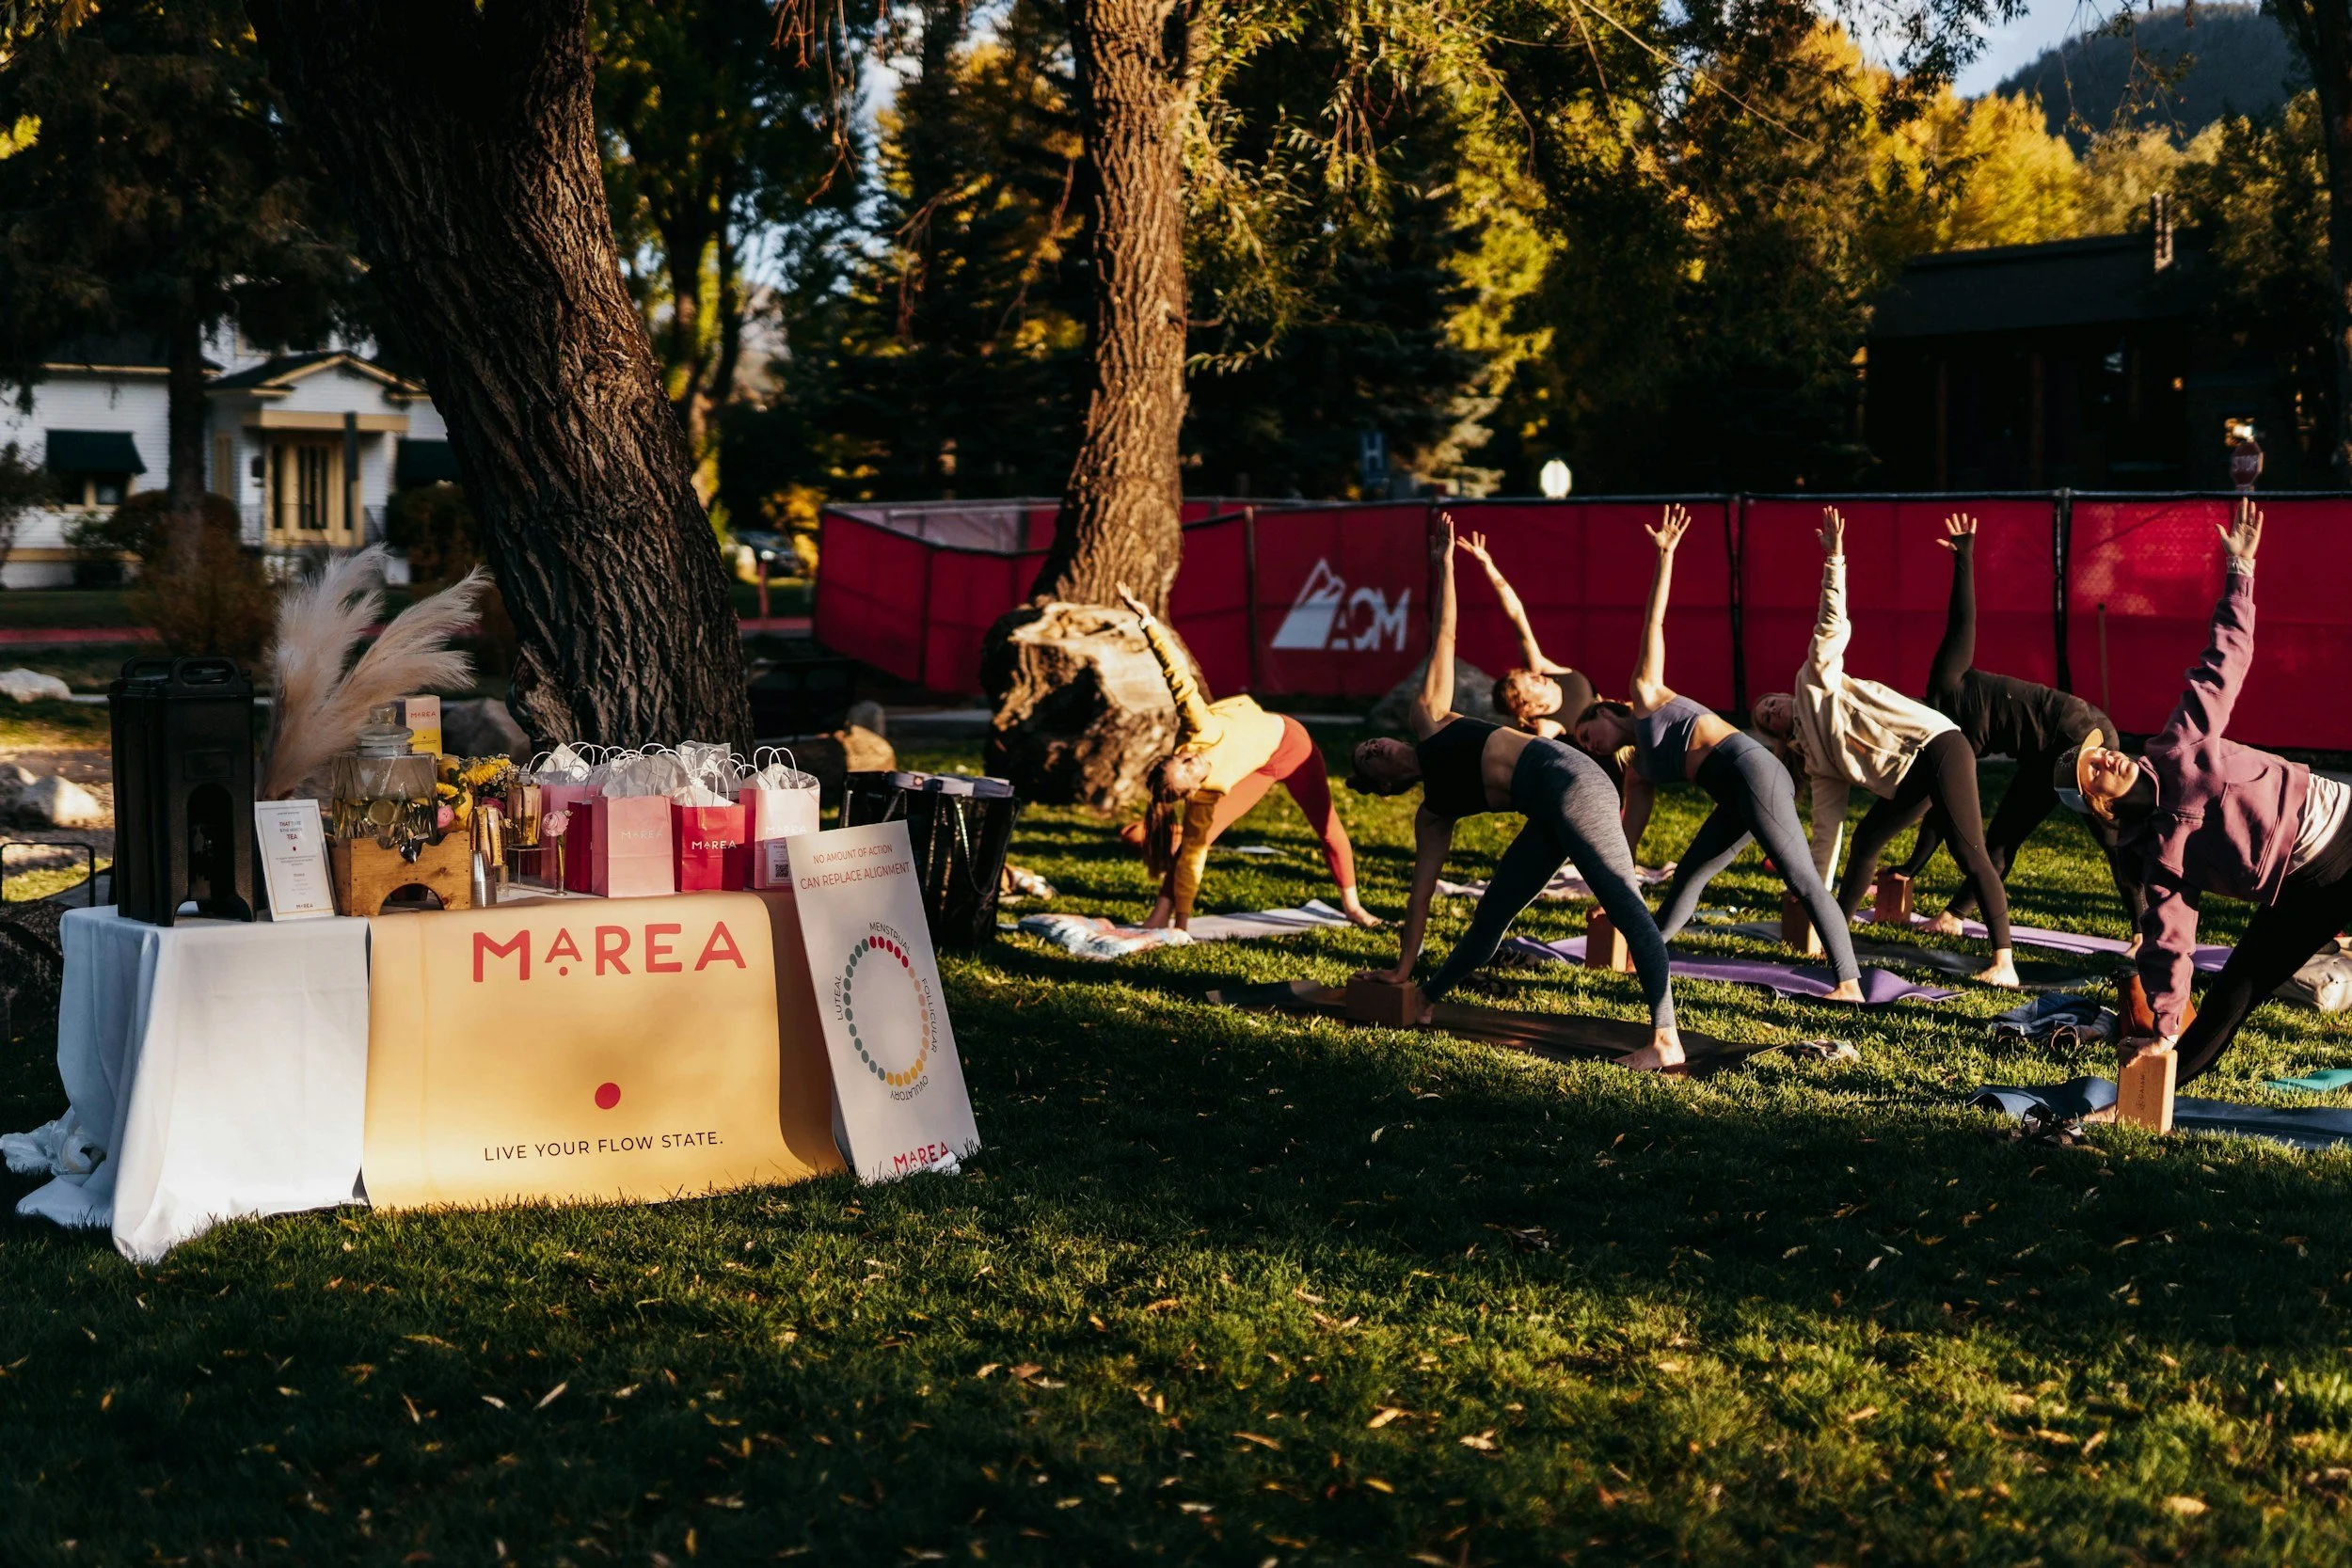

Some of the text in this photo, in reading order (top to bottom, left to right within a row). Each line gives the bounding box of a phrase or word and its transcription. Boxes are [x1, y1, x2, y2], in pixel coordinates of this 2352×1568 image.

[1362, 434, 1383, 470] H
[621, 829, 663, 840] MAREA
[766, 825, 806, 834] MAREA
[691, 839, 738, 850] MAREA
[813, 844, 893, 864] NO AMOUNT OF ACTION
[800, 862, 911, 890] CAN REPLACE ALIGNMENT
[472, 920, 747, 982] MAREA
[869, 922, 912, 957] MENSTRUAL
[921, 978, 938, 1053] FOLLICULAR
[889, 1075, 930, 1101] OVULATORY
[485, 1131, 723, 1161] LIVE YOUR FLOW STATE.
[893, 1141, 948, 1175] MAREA
